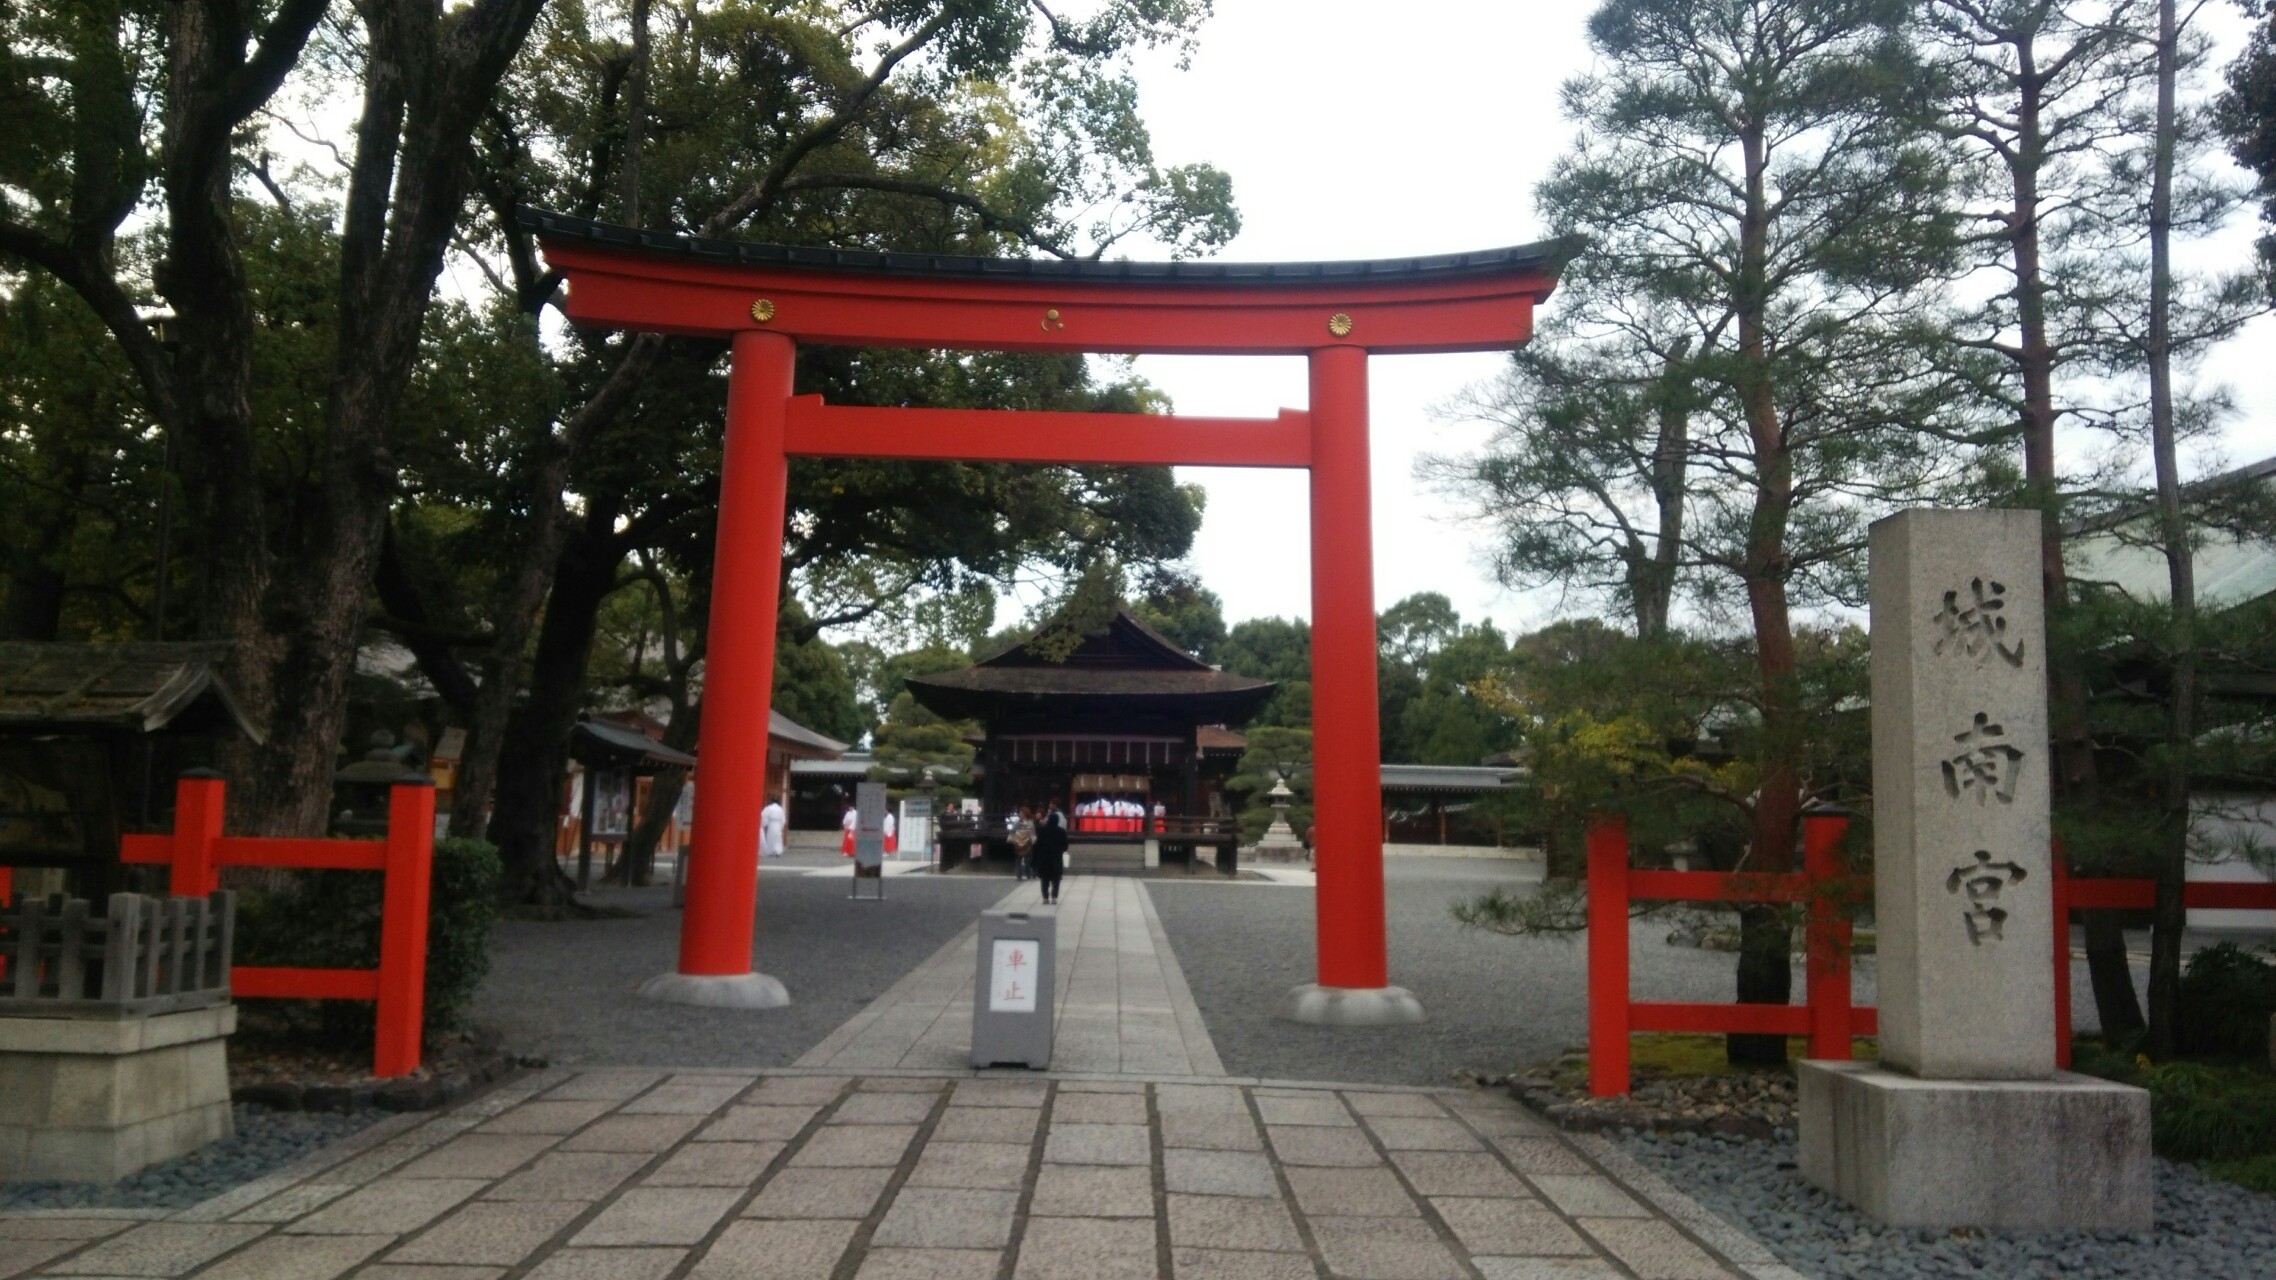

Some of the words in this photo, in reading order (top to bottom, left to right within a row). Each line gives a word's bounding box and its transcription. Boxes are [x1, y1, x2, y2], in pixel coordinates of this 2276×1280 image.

[1933, 576, 2028, 946] 城南宮
[1004, 948, 1027, 1000] 車止
